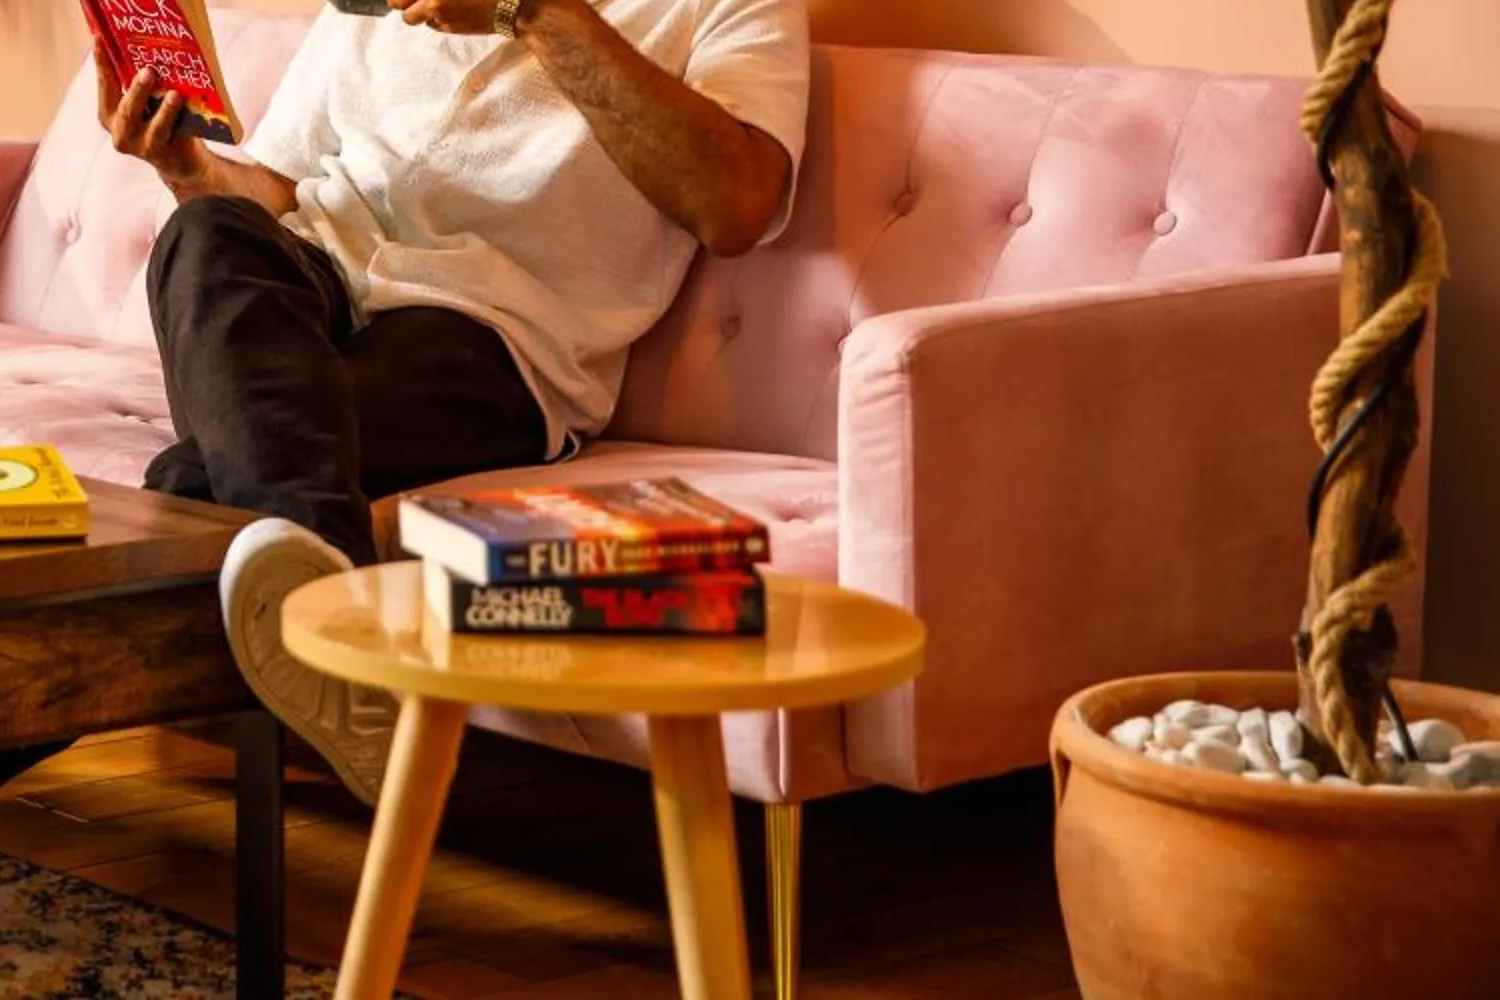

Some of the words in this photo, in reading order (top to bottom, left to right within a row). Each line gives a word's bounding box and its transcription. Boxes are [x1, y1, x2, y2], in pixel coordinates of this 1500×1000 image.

[112, 14, 194, 41] MOFINA
[127, 43, 205, 71] SEARCH
[174, 66, 215, 91] HER
[529, 539, 619, 578] FURY
[471, 586, 563, 605] MICHAEL
[465, 604, 574, 629] CONNELLY
